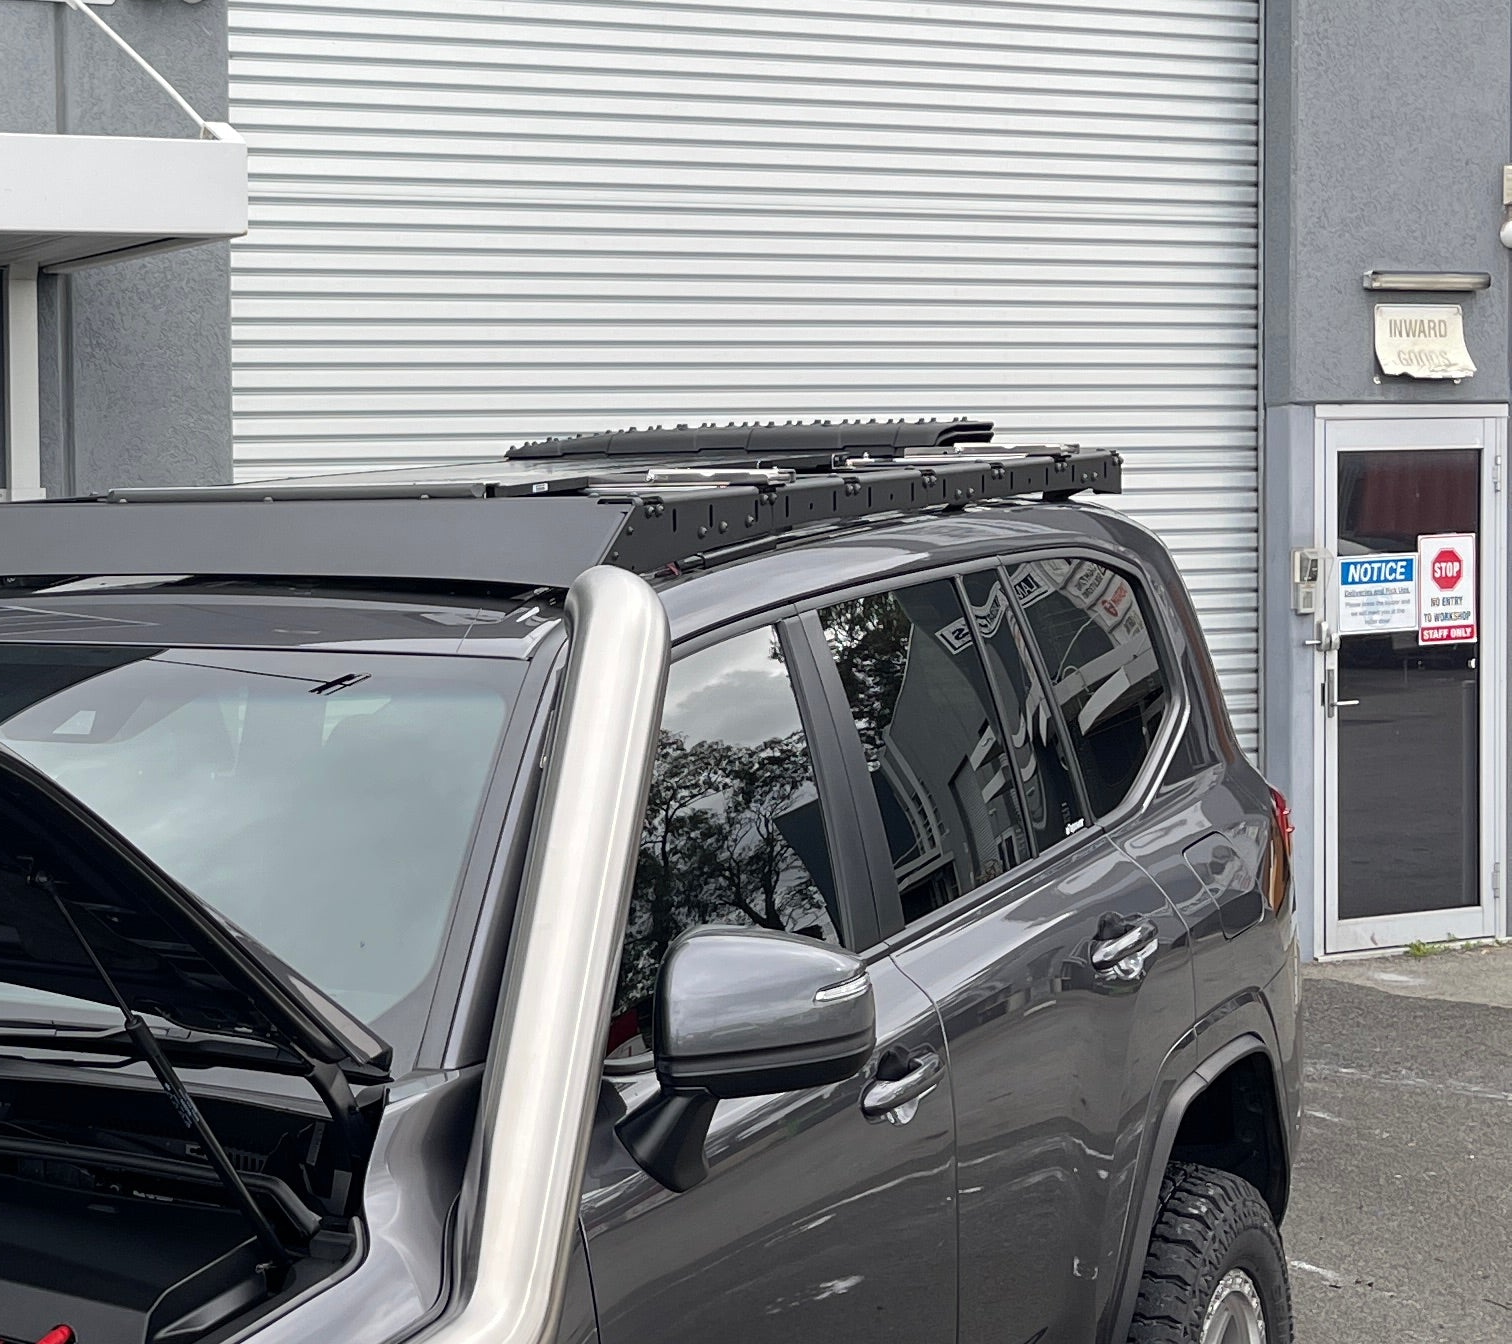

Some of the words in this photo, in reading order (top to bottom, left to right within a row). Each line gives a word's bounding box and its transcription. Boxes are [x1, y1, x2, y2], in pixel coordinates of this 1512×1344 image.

[1389, 318, 1448, 338] INWARD
[1348, 560, 1407, 583] NOTICE
[1433, 561, 1461, 578] STOP
[1430, 597, 1440, 607] NO
[1441, 596, 1463, 607] ENTRY
[1424, 613, 1432, 623] TO
[1433, 610, 1471, 623] WORKSHOP
[1422, 629, 1448, 640] STAFF
[1450, 627, 1471, 638] ONLY
